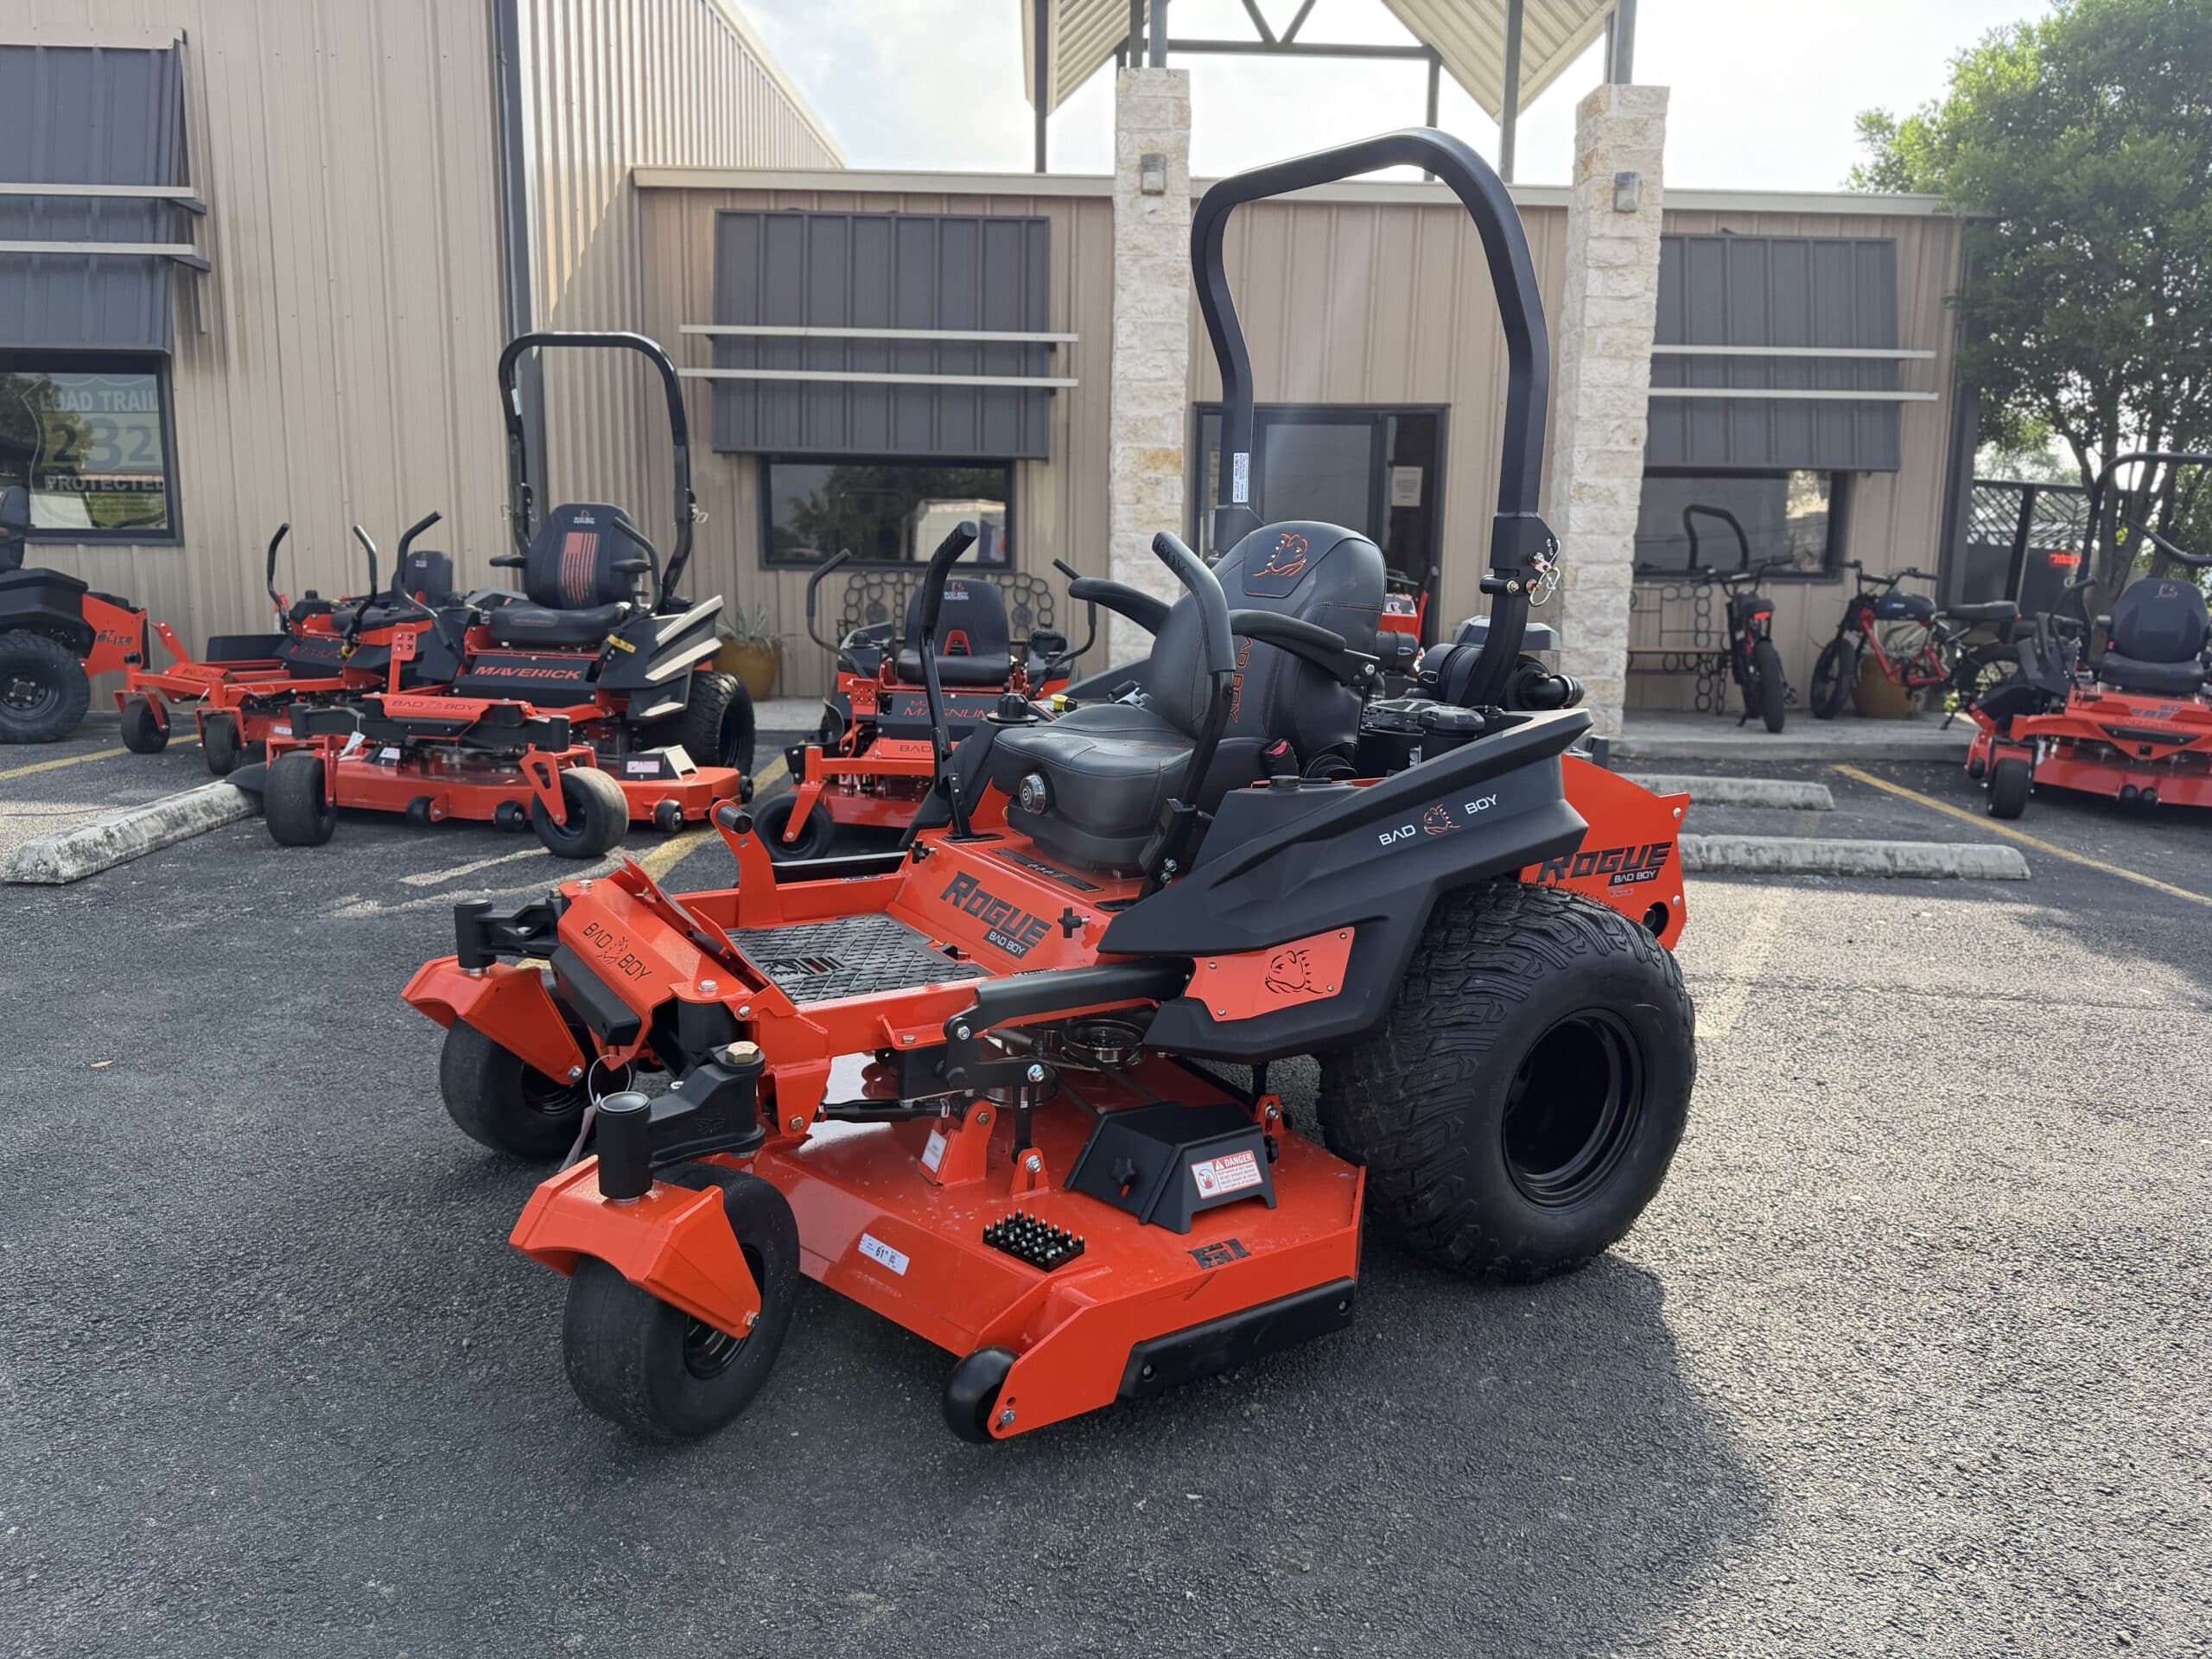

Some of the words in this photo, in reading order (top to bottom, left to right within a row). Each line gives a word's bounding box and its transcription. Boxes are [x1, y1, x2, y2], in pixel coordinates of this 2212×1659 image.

[40, 391, 93, 411] LOAD
[1237, 636, 1253, 668] AD
[474, 665, 582, 680] MAVERICK
[1378, 824, 1416, 846] BAD
[1465, 793, 1497, 815] BOY
[1536, 842, 1673, 882] ROGUE
[1614, 873, 1635, 883] BAD
[1636, 870, 1656, 880] BOY
[940, 871, 1052, 948] ROGUE
[582, 922, 613, 949] BAD
[618, 953, 652, 982] BOY
[988, 931, 1007, 946] BAD
[1006, 940, 1026, 955] BOY
[1224, 1153, 1253, 1166] DANGER
